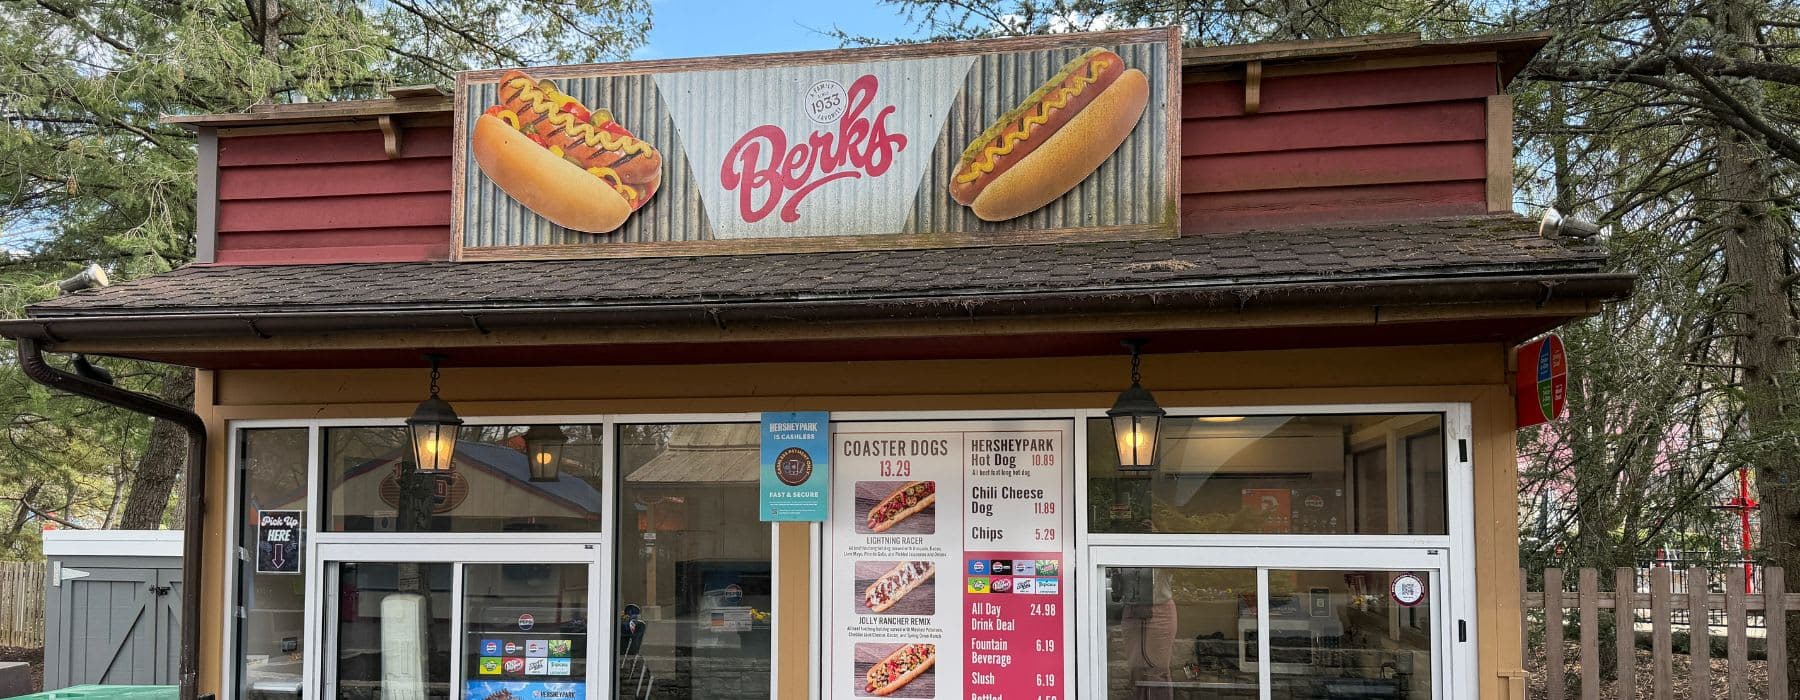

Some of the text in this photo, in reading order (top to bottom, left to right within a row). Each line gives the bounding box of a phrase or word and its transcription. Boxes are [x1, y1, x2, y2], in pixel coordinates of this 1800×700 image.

[811, 92, 841, 115] 1933
[720, 74, 908, 224] Berks
[769, 422, 818, 432] HERSHEYPARK
[843, 439, 949, 457] COASTER DOGS
[971, 439, 1054, 452] HERSHEYPARK
[879, 460, 911, 477] 13.29
[971, 453, 1055, 469] Hot Dog 10.89
[972, 486, 1044, 499] Chili Cheese
[971, 501, 1055, 517] Dog 11.89
[261, 516, 298, 528] Pick Up
[267, 530, 291, 541] HERE
[866, 537, 923, 545] LIGHTNING RACER
[971, 526, 1055, 542] Chips 5.29
[971, 602, 1056, 618] All Day 24.98
[859, 616, 931, 626] JOLLY RANCHER REMIX
[971, 618, 1015, 631] Drink Deal
[971, 637, 1055, 652] Fountain 6.19
[971, 651, 1012, 668] Beverage
[971, 671, 1055, 687] Slush 6.19
